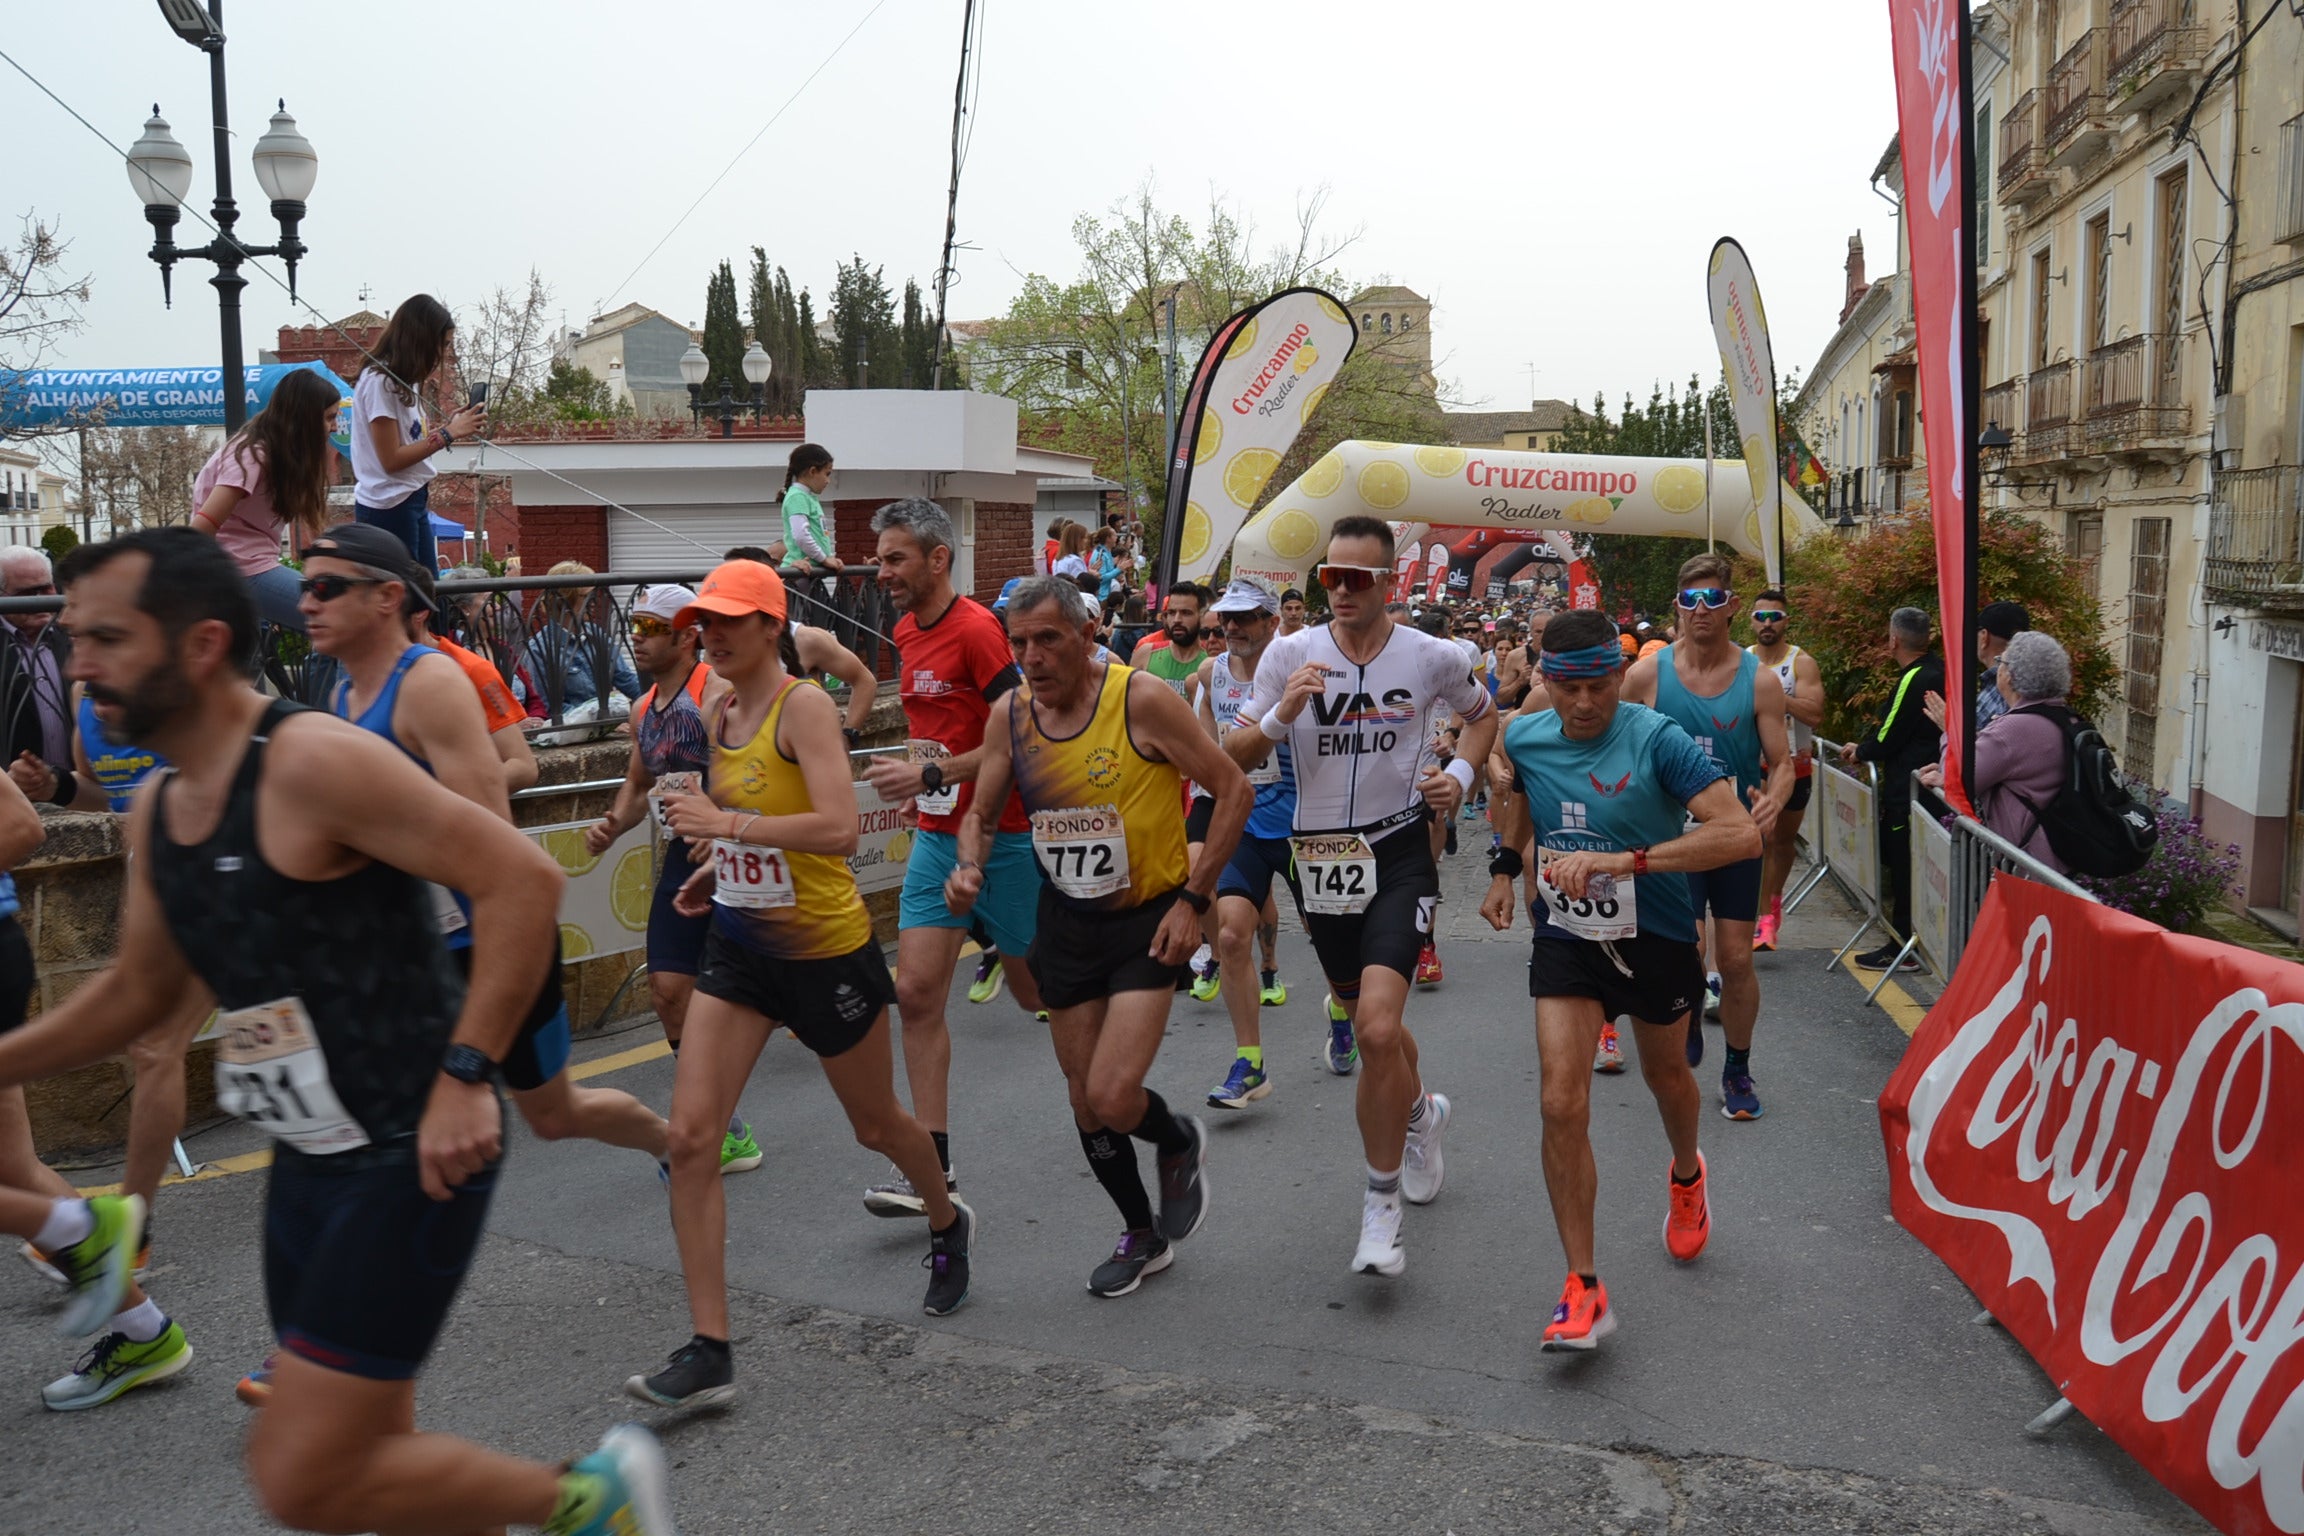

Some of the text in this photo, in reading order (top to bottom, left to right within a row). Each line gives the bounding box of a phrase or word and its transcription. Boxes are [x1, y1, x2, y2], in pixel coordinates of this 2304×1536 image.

[25, 368, 263, 386] AYUNTAMIENTO E
[1232, 321, 1310, 415] Cruzcampo
[26, 388, 260, 407] ALHAMA DE GRANAA
[1258, 374, 1300, 417] Radler
[143, 409, 161, 419] DE
[1466, 458, 1637, 497] Cruzcampo
[1481, 495, 1562, 522] Radler
[1311, 688, 1416, 727] VAS
[1317, 730, 1397, 757] EMILIO
[1047, 817, 1104, 834] FONDO
[1308, 838, 1359, 855] FONDO
[1544, 840, 1613, 852] INNOVENT
[716, 846, 783, 885] 2181
[1046, 843, 1114, 878] 772
[1308, 864, 1366, 896] 742
